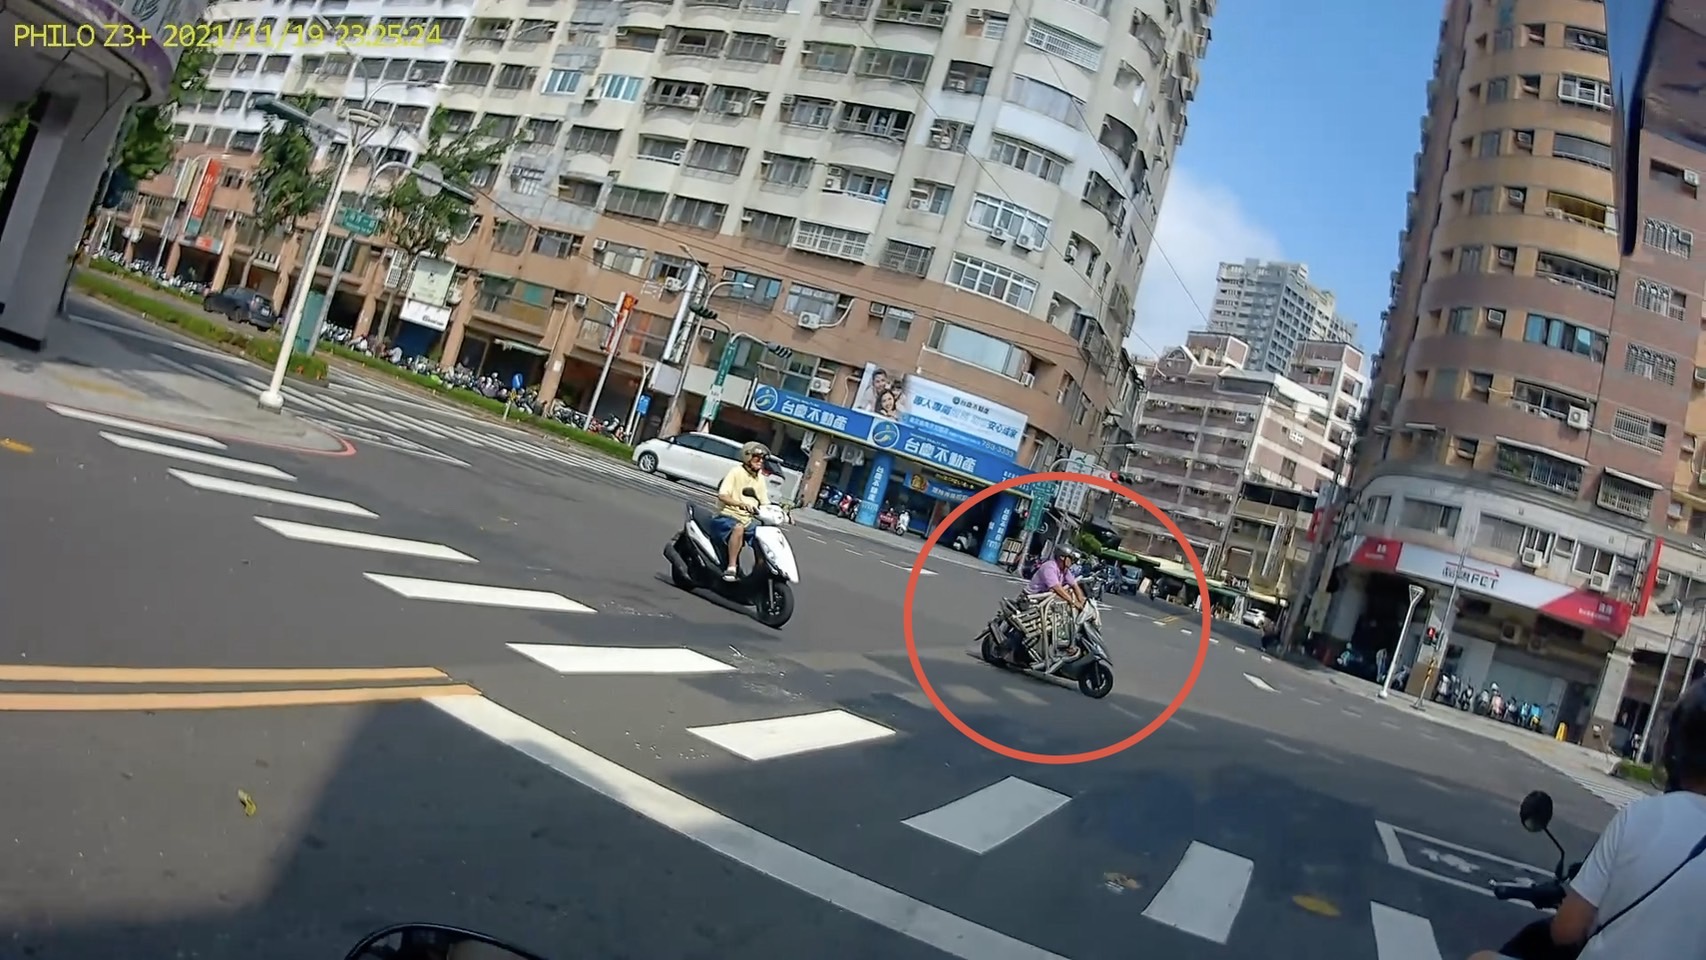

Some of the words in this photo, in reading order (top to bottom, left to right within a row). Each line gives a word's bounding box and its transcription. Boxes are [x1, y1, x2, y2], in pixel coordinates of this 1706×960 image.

[781, 400, 848, 431] 台慶不動產
[904, 438, 977, 473] 台慶不動產
